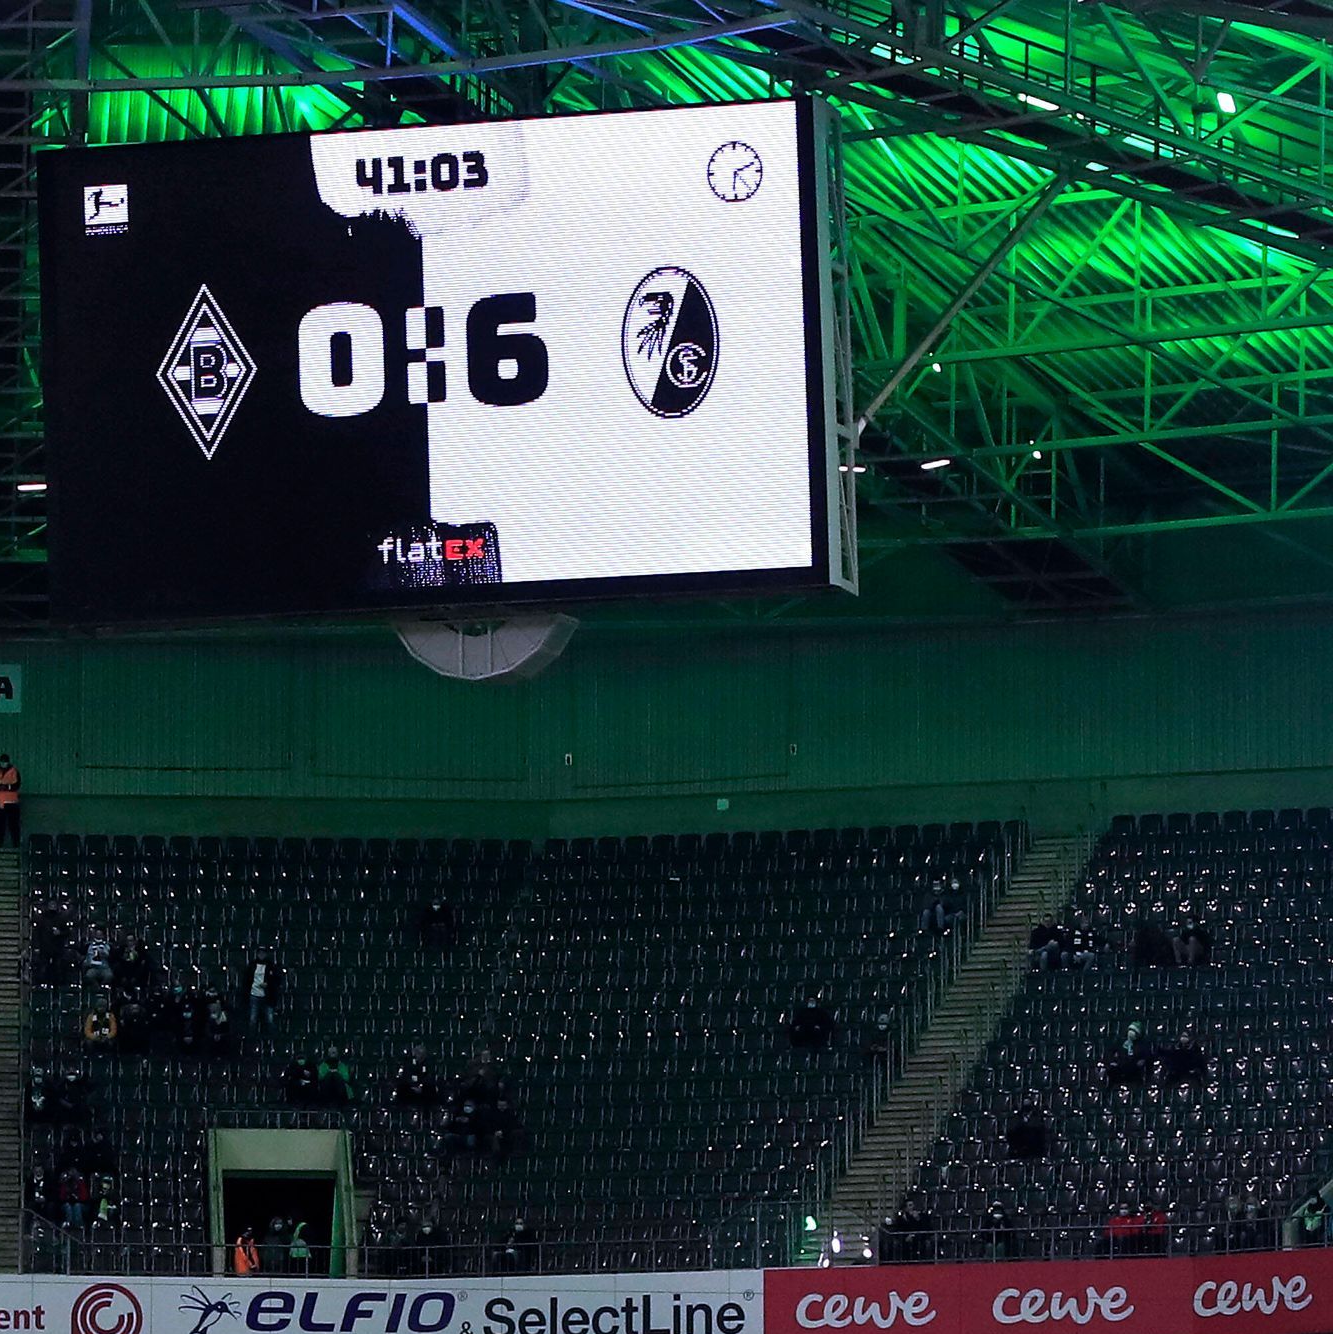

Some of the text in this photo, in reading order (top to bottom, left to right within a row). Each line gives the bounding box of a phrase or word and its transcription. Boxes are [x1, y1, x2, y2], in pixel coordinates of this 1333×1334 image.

[355, 151, 489, 195] 41:03
[796, 1290, 936, 1329] cewe
[993, 1286, 1134, 1325] cewe
[1193, 1274, 1313, 1319] cewe
